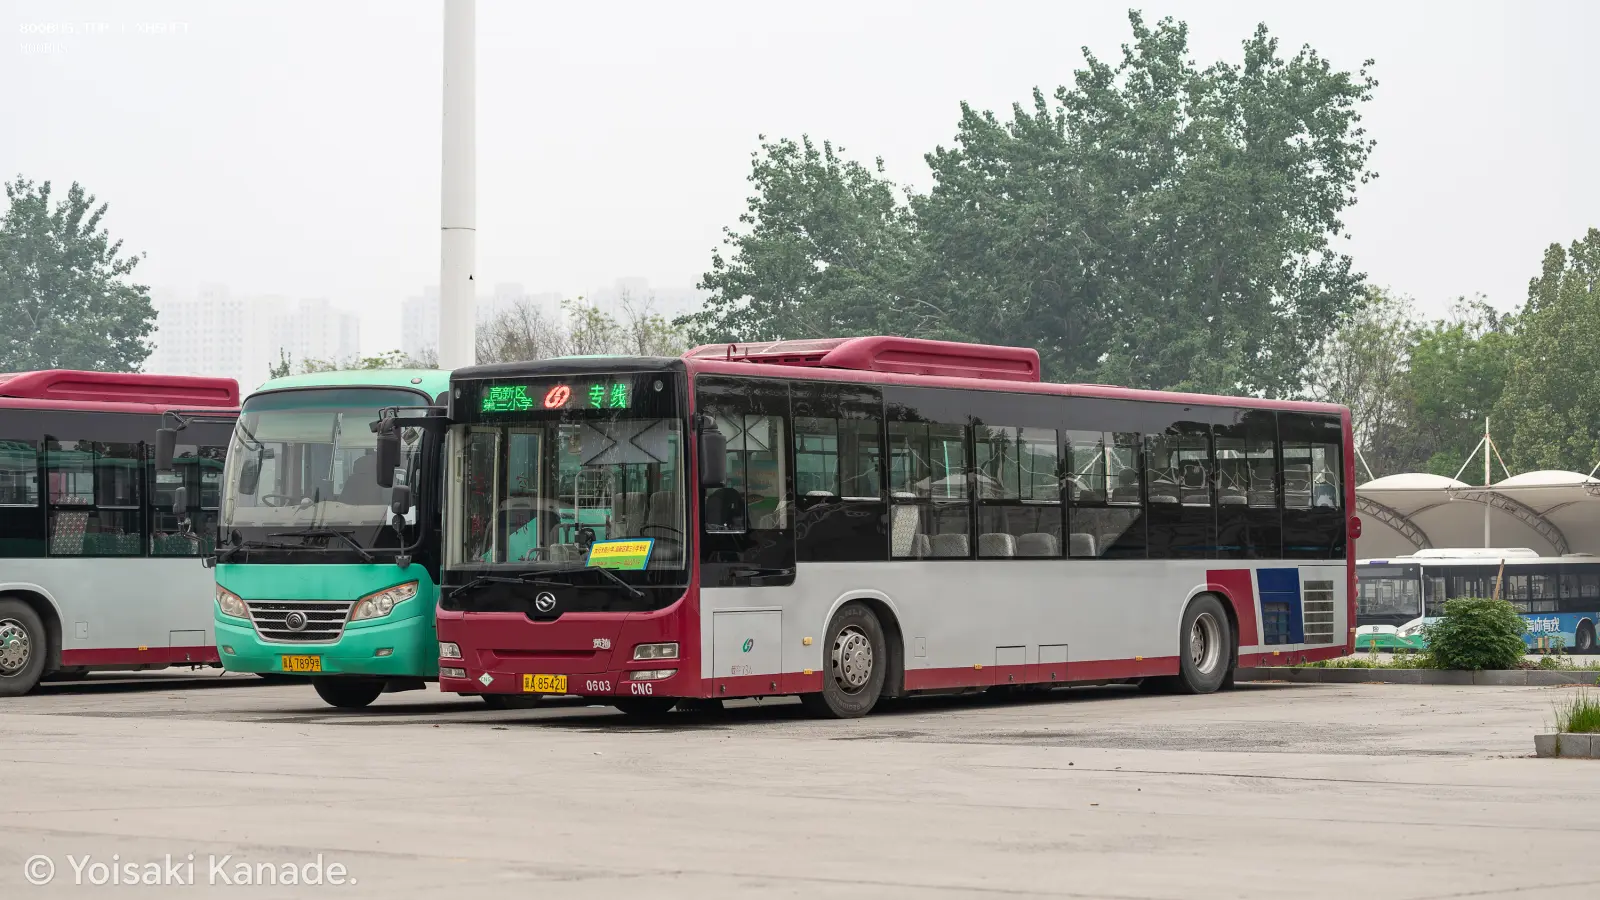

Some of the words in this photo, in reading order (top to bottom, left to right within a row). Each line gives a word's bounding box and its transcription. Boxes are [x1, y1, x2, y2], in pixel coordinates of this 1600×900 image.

[490, 386, 528, 400] 高新区
[589, 383, 626, 408] 专线
[586, 680, 611, 692] 0603
[631, 683, 653, 695] CNG
